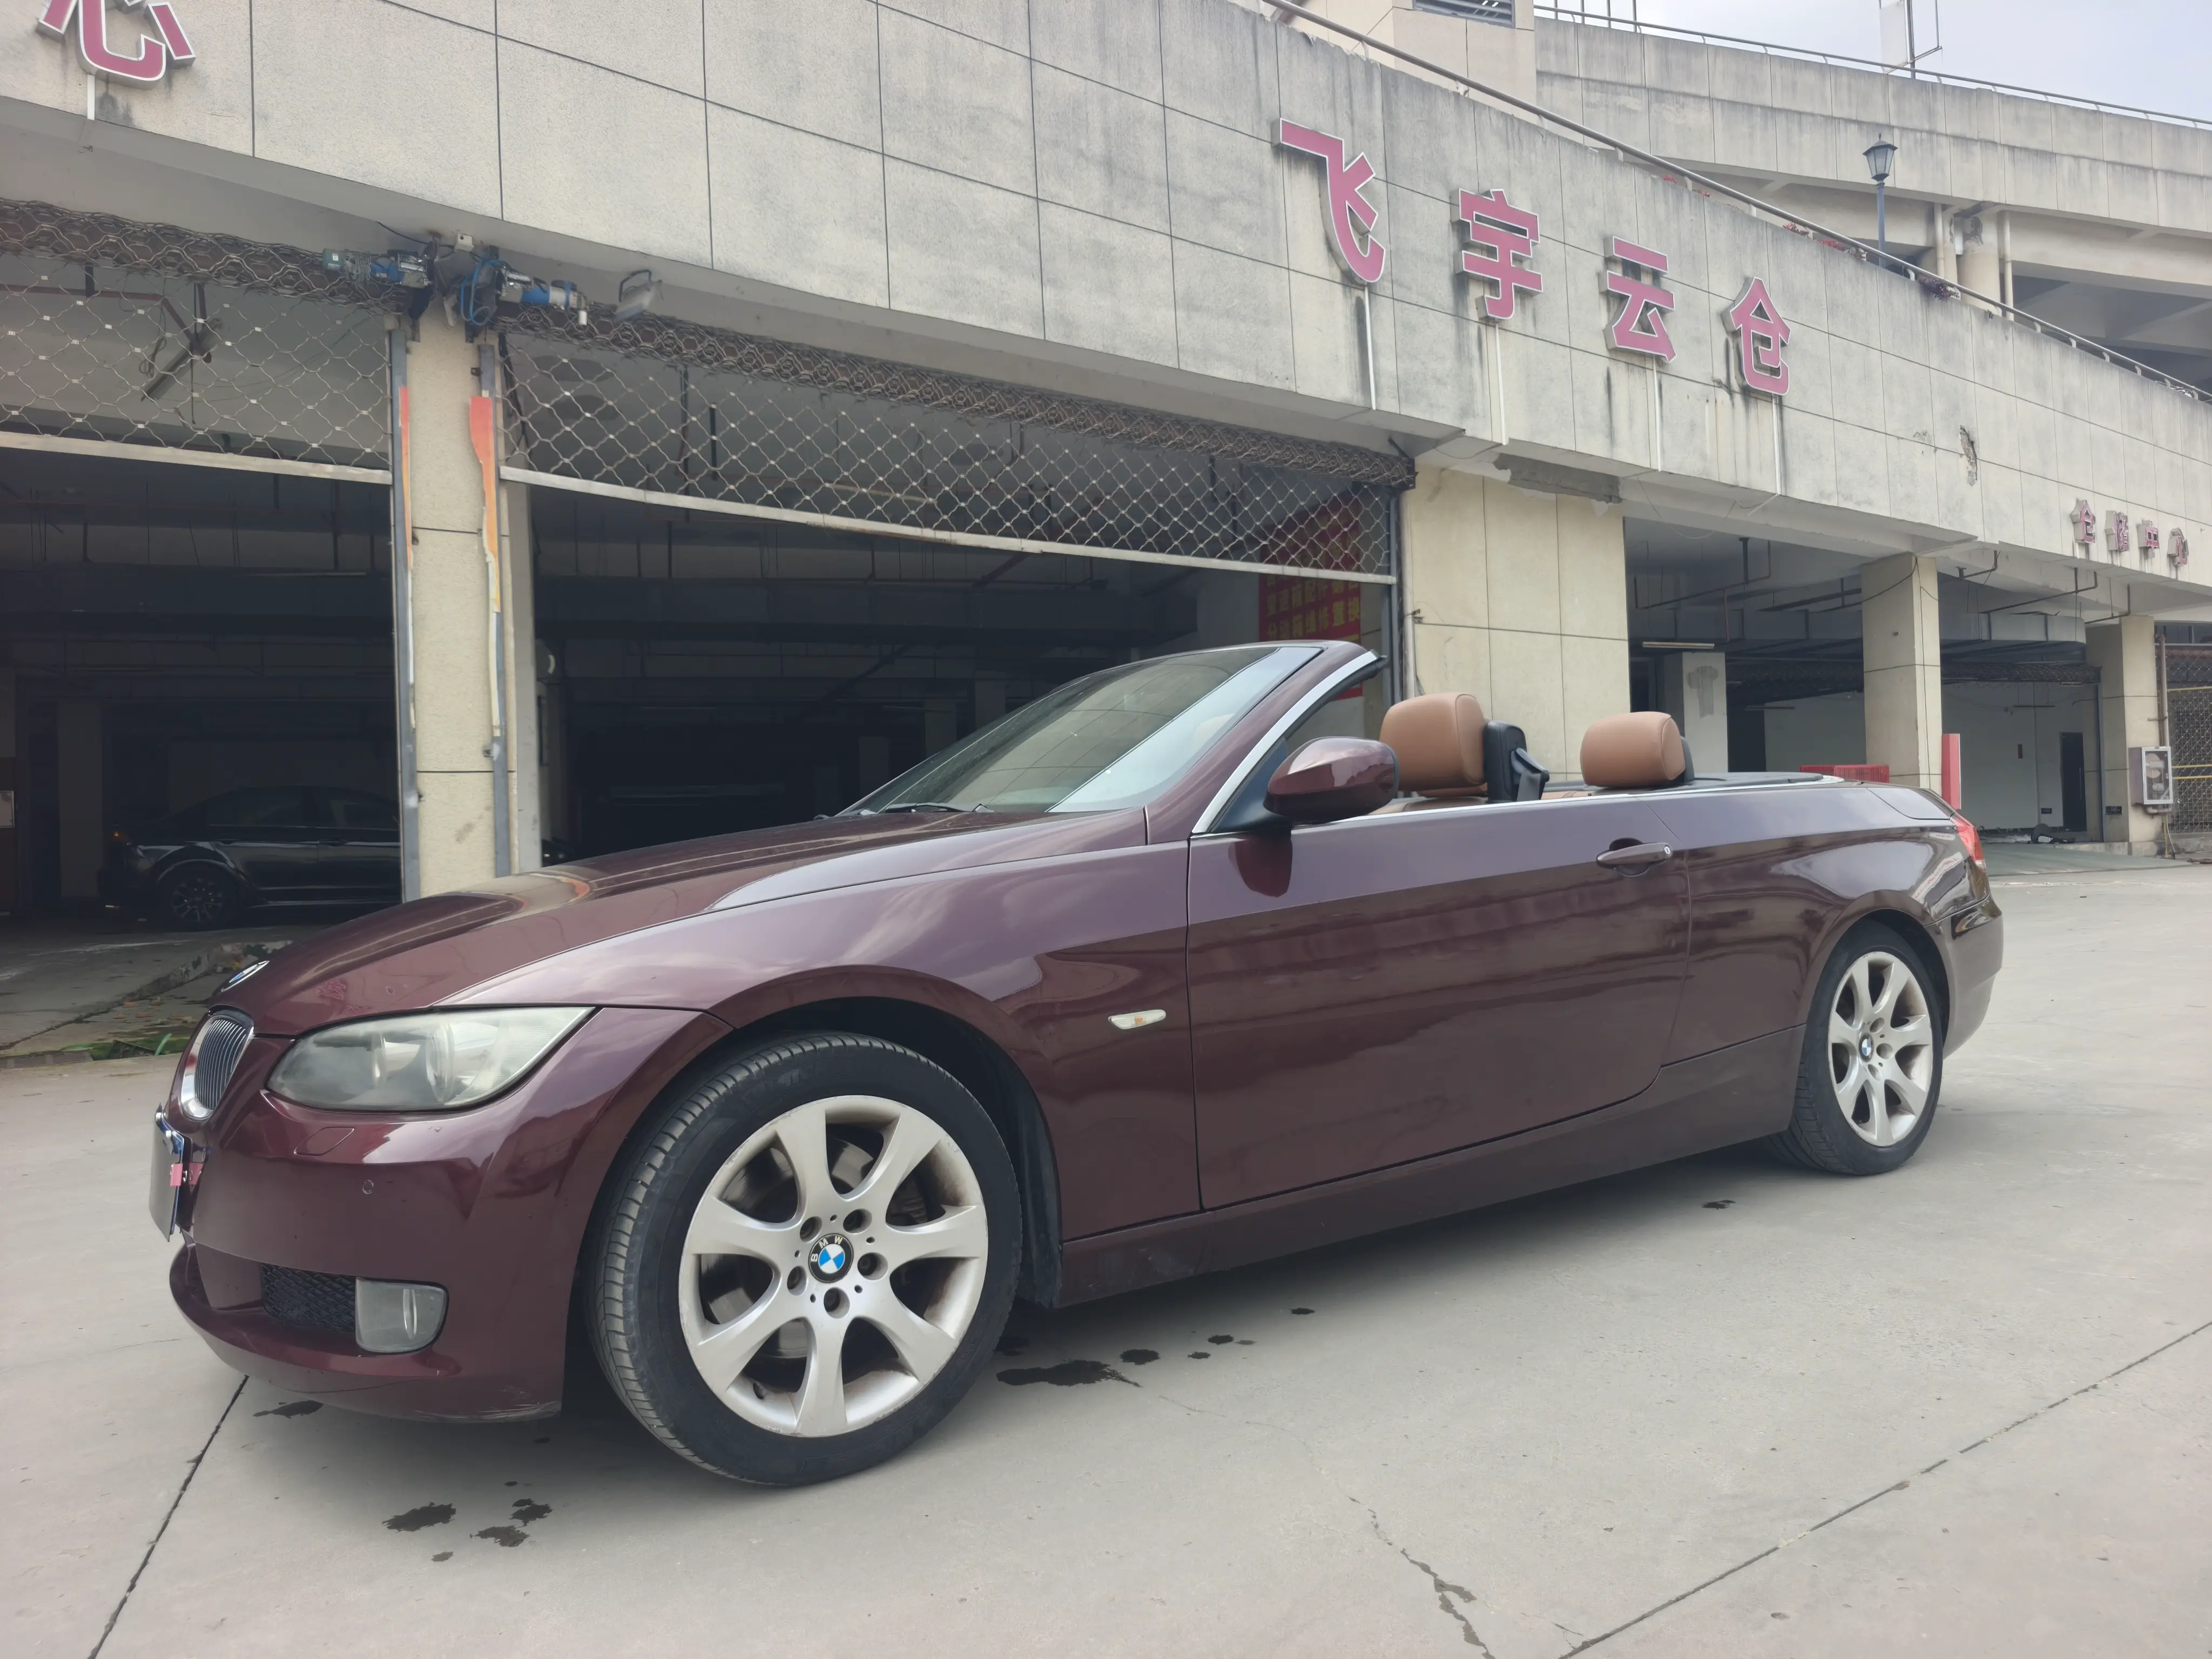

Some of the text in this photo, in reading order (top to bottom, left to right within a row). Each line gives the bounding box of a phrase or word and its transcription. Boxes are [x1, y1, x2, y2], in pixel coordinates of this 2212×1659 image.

[38, 0, 197, 81] 心
[1278, 117, 1791, 396] 飞宇云仓
[811, 1236, 842, 1262] BMW
